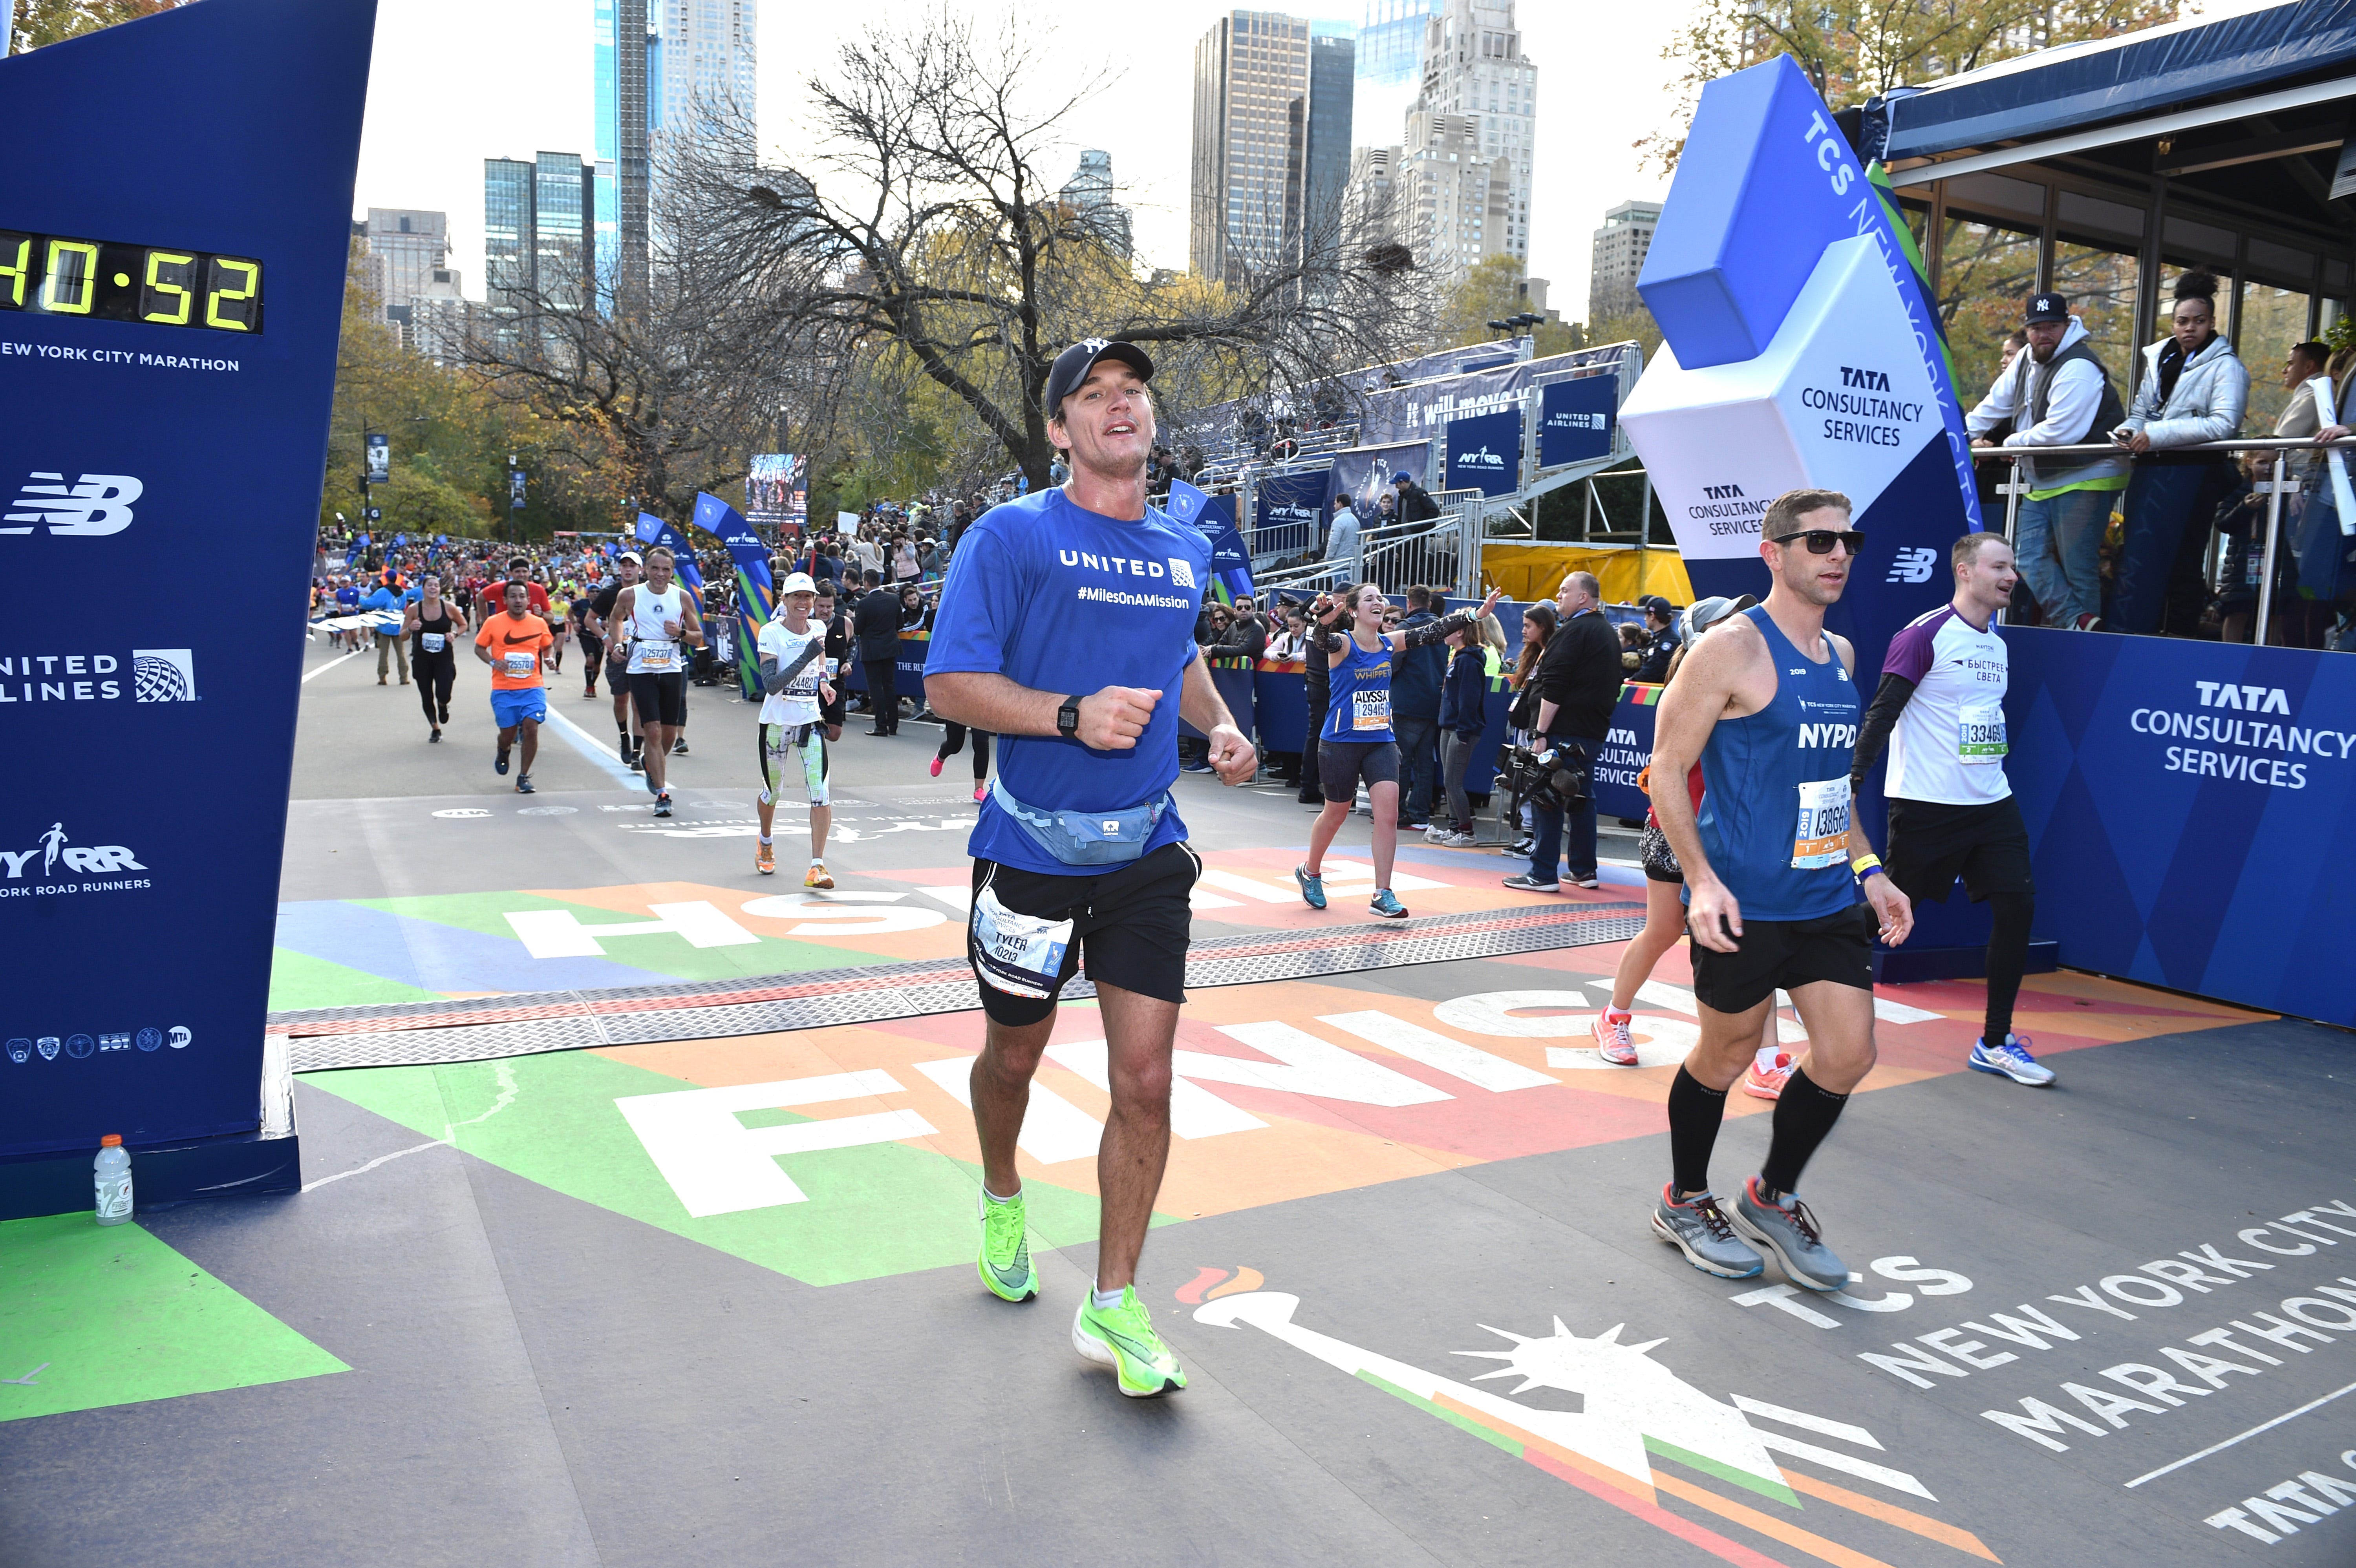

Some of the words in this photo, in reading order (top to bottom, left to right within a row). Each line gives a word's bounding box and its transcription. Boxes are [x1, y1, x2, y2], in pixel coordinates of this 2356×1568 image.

[2036, 299, 2050, 311] NY
[1805, 110, 1855, 196] TCS
[1947, 431, 1978, 526] CITY
[1083, 337, 1110, 354] NY
[2, 342, 32, 356] EW
[37, 344, 88, 360] YORK
[93, 349, 134, 364] CITY
[139, 353, 239, 371] MARATHON
[1840, 366, 1891, 392] TATA
[1407, 402, 1419, 428] It
[1424, 394, 1454, 426] will
[1458, 391, 1510, 420] move
[1802, 387, 1924, 422] CONSULTANCY
[1547, 419, 1590, 428] AIRLINES
[1556, 413, 1590, 421] UNITED
[1824, 419, 1900, 446] SERVICES
[1377, 459, 1387, 468] TCS
[1458, 453, 1504, 464] NYRR
[1703, 484, 1745, 500] TATA
[371, 509, 379, 517] G
[1362, 510, 1373, 519] CITY
[1059, 550, 1165, 578] UNITED
[1077, 587, 1189, 610] #MilesOnAMission
[647, 649, 668, 658] 25737
[0, 654, 117, 676] NITED
[510, 660, 530, 669] 25578
[897, 662, 912, 671] THE
[1968, 659, 2005, 673] БЫСТРЕЕ
[791, 677, 813, 689] 24482
[1977, 671, 2001, 683] СВЕТА
[0, 680, 120, 703] LINES
[1355, 691, 1388, 704] ALYSSA
[2195, 680, 2290, 715] TATA
[1362, 704, 1385, 716] 29415
[1605, 728, 1637, 746] ATA
[1798, 723, 1857, 749] NYPD
[2131, 708, 2356, 759] CONSULTANCY
[1597, 747, 1653, 768] SULTANC
[2164, 746, 2307, 789] SERVICES
[1799, 811, 1809, 837] 2019
[0, 845, 149, 878] YRR
[0, 886, 30, 898] ORK
[36, 884, 77, 895] ROAD
[82, 879, 151, 893] RUNNERS
[998, 910, 1016, 920] TATA
[992, 919, 1016, 933] SERVICES
[996, 931, 1028, 951] TYLER
[994, 945, 1018, 962] 10213
[1021, 977, 1043, 987] RUNNERS
[101, 1038, 129, 1051] DOT
[168, 1032, 188, 1044] MTA
[1701, 1087, 1721, 1098] RUN
[1818, 1089, 1840, 1100] RUN
[1729, 1254, 1974, 1330] TCS
[1856, 1303, 2082, 1390] NEW
[2046, 1242, 2276, 1322] YORK
